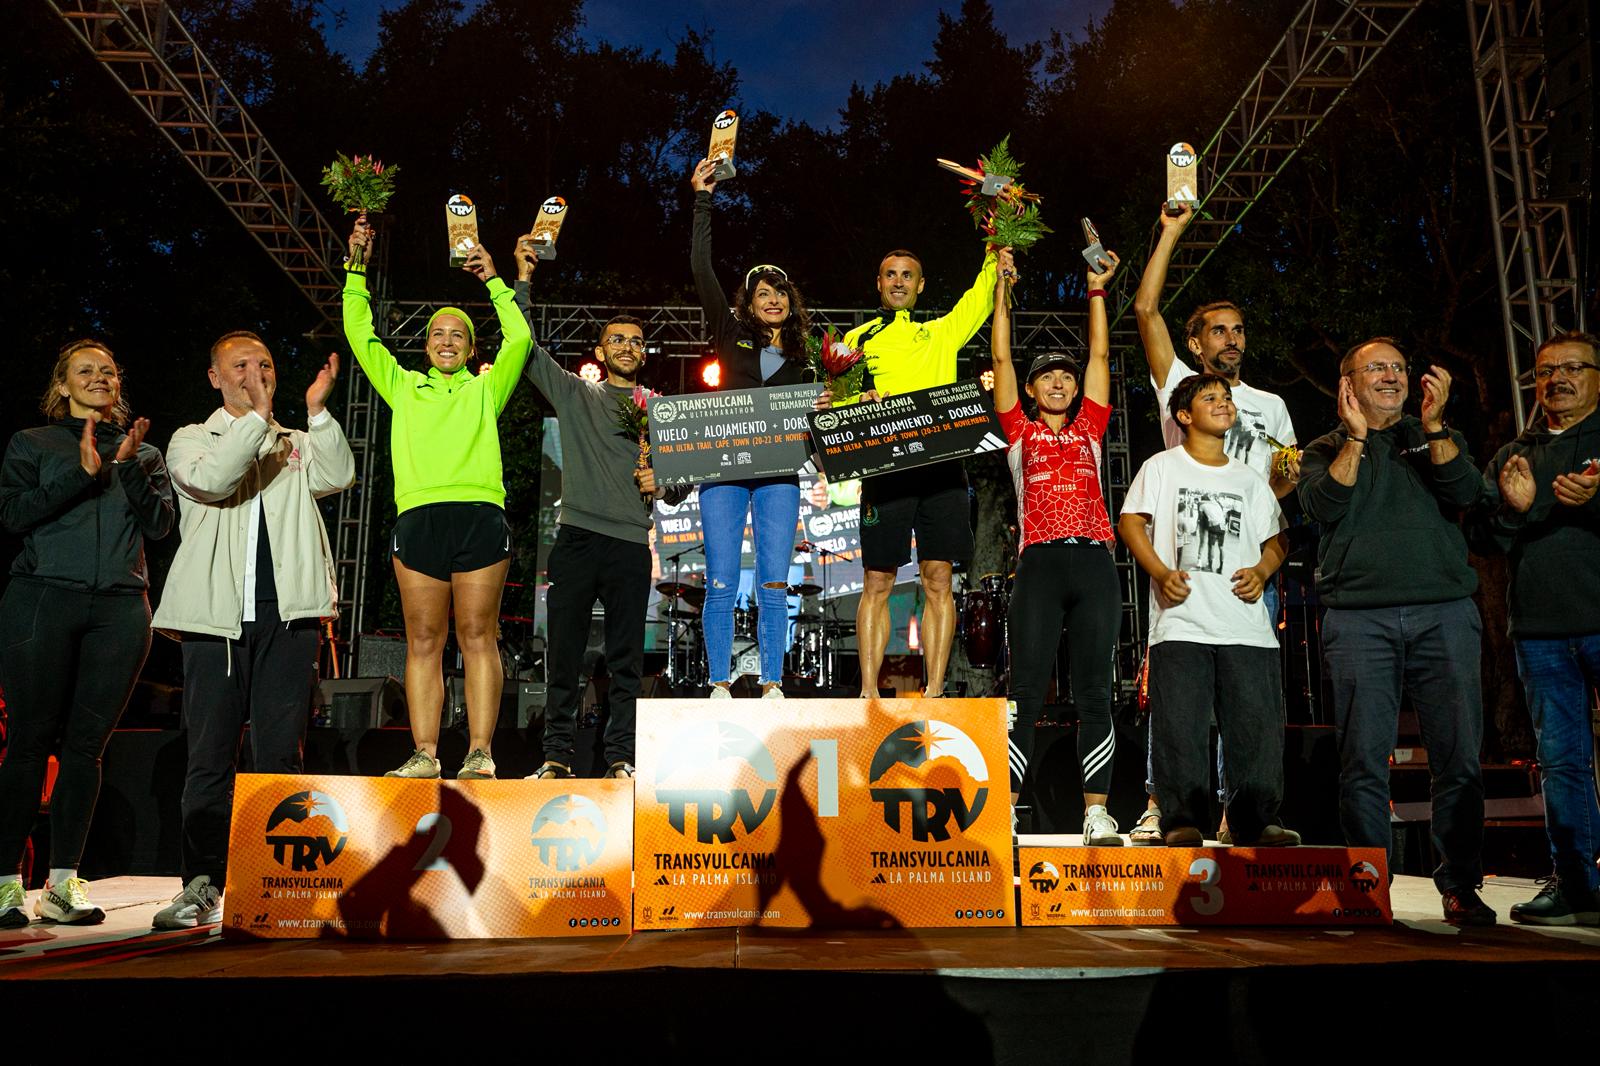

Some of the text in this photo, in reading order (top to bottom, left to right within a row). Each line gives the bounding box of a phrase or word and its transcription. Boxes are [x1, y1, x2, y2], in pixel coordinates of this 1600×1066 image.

[449, 205, 473, 215] TRV
[543, 205, 566, 214] TRV
[769, 389, 817, 401] PRIMERA PALMERA
[928, 383, 977, 399] PRIMER PALMERO
[931, 390, 980, 406] ULTRAMARATÓN
[676, 394, 754, 411] TRANSVULCANIA
[836, 396, 914, 420] TRANSVULCANIA
[690, 406, 755, 419] ULTRAMARATHON
[852, 405, 917, 423] ULTRAMARATHON
[657, 427, 688, 442] VUELO
[704, 420, 767, 439] ALOJAMIENTO
[783, 416, 810, 431] DORS
[821, 430, 854, 446] VUELO
[870, 414, 933, 436] ALOJAMIENTO
[948, 403, 986, 420] DORSAL
[825, 415, 990, 456] PARA ULTRA TRAIL CAPE TOWN (20-22 DE NOVIEMBRE)
[658, 444, 674, 454] PARA
[676, 442, 695, 452] ULTRA
[697, 440, 713, 450] TRAIL
[715, 439, 730, 448] CAPE
[733, 437, 750, 447] TOWN
[752, 435, 772, 447] (20-22
[774, 434, 782, 443] DE
[660, 517, 692, 533] VUELO
[809, 738, 839, 817] 1
[655, 788, 777, 845] TRV
[869, 787, 989, 843] TRV
[412, 812, 453, 871] 2
[265, 835, 348, 873] TRV
[531, 837, 607, 872] TRV
[654, 852, 777, 870] TRANSVULCANIA
[870, 850, 991, 868] TRANSVULCANIA
[890, 871, 991, 884] LA PALMA ISLAND
[1063, 863, 1163, 879] TRANSVULCANIA
[1245, 863, 1343, 879] TRANSVULCANIA
[261, 876, 344, 889] TRANSVULCANIA
[529, 876, 606, 889] TRANSVULCANIA
[673, 873, 777, 886] LA PALMA ISLAND
[1029, 878, 1060, 894] TRV
[1080, 880, 1164, 892] LA PALMA ISLAND
[1189, 857, 1225, 915] 3
[1262, 881, 1345, 892] LA PALMA ISLAND
[273, 890, 343, 899] LA PALMA ISLAND
[540, 890, 606, 899] LA PALMA ISLAND
[683, 908, 780, 920] www.transvulcania.com
[1070, 905, 1165, 917] www.transvulcania.com
